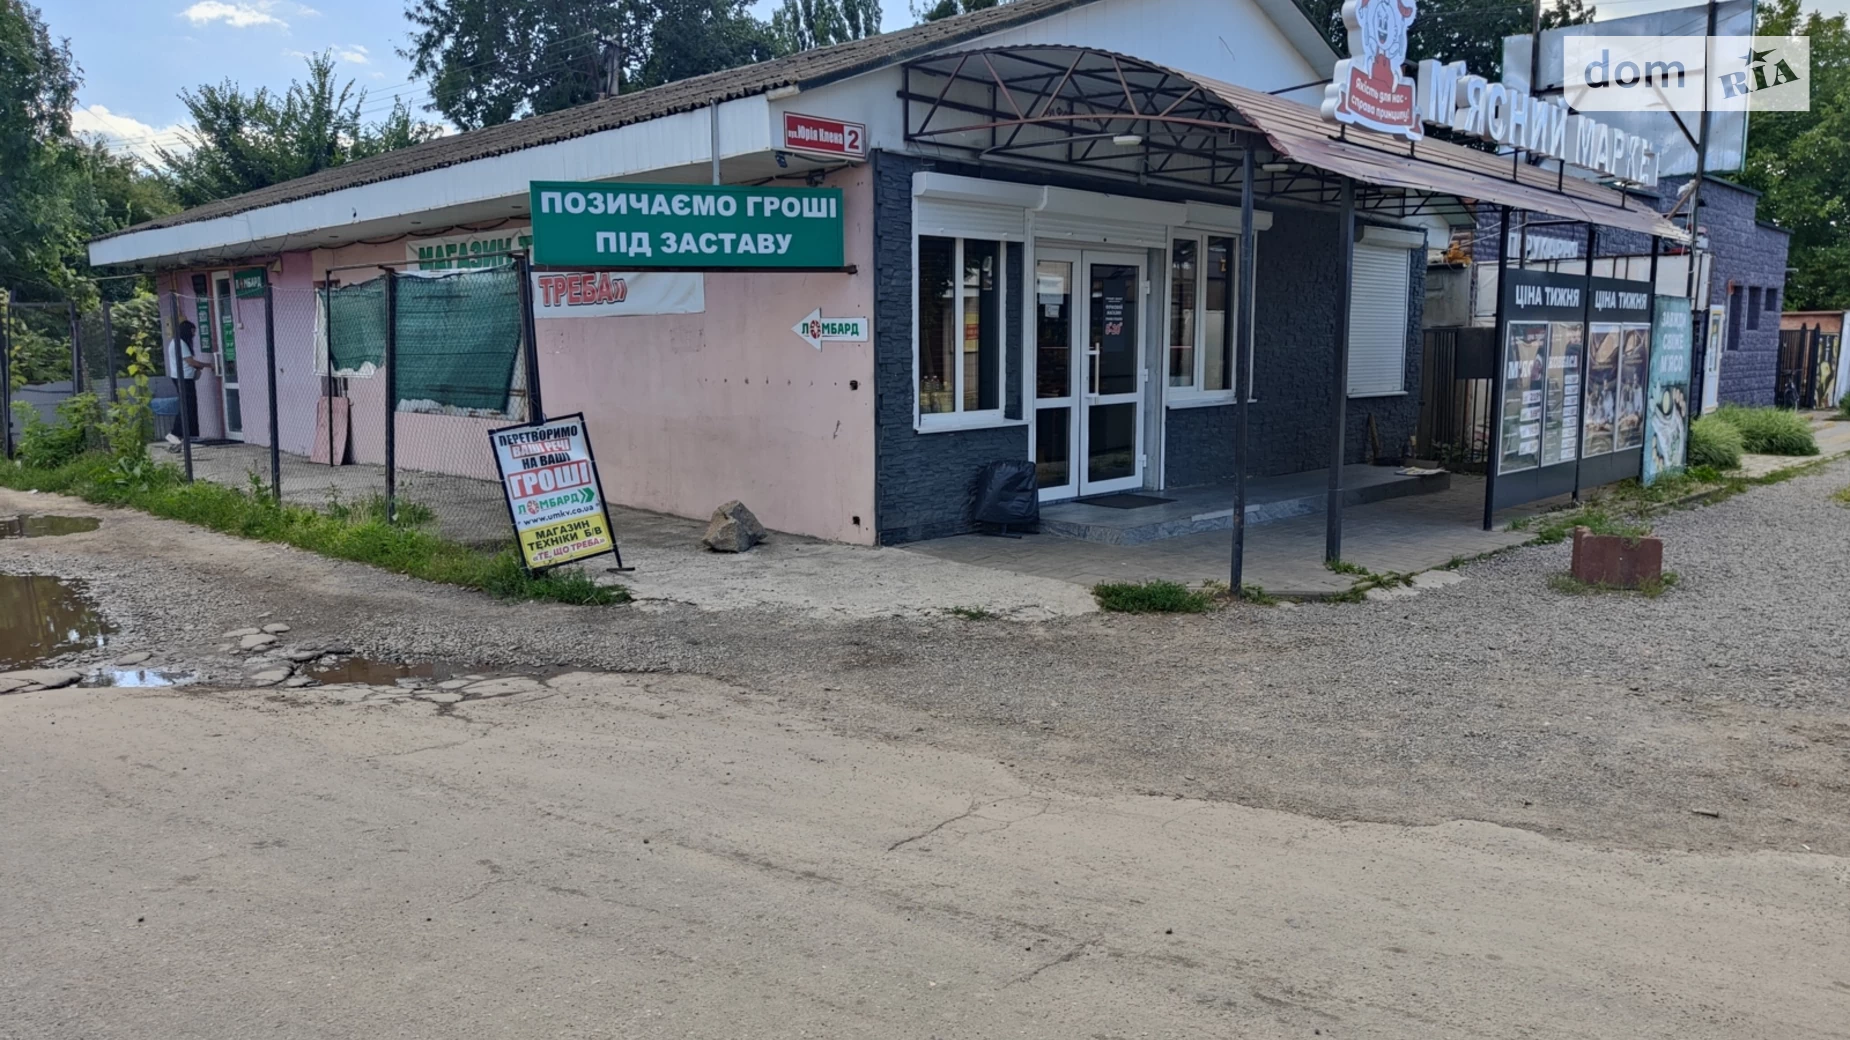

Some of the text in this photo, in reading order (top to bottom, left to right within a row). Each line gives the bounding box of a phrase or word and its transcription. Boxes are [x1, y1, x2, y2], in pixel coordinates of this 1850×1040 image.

[818, 128, 844, 145] Клена
[847, 130, 860, 150] 2
[540, 191, 837, 218] ПОЗИЧАЄМО ГРОШІ
[419, 237, 513, 270] МАГАЗИН
[596, 231, 793, 257] ПІД ЗАСТАВУ
[538, 272, 628, 307] ТРЕБА»
[1515, 284, 1580, 309] ЦІНА ТИЖНЯ
[1594, 290, 1648, 312] ЦІНА ТИЖНЯ
[801, 319, 860, 339] ЛОМБАРД
[498, 425, 578, 447] ПЕРЕТВОРИМО
[512, 439, 570, 458] ВАШІ РЕЧІ
[521, 451, 571, 470] НА ВАШІ
[509, 461, 591, 498] ГРОШІ
[523, 505, 594, 526] www.umkv.co.ua
[527, 526, 603, 551] ТЕХНІКИ Б/В
[535, 520, 590, 540] МАГАЗИН
[553, 546, 570, 556] ЩО
[570, 538, 605, 551] ТРЕБА»
